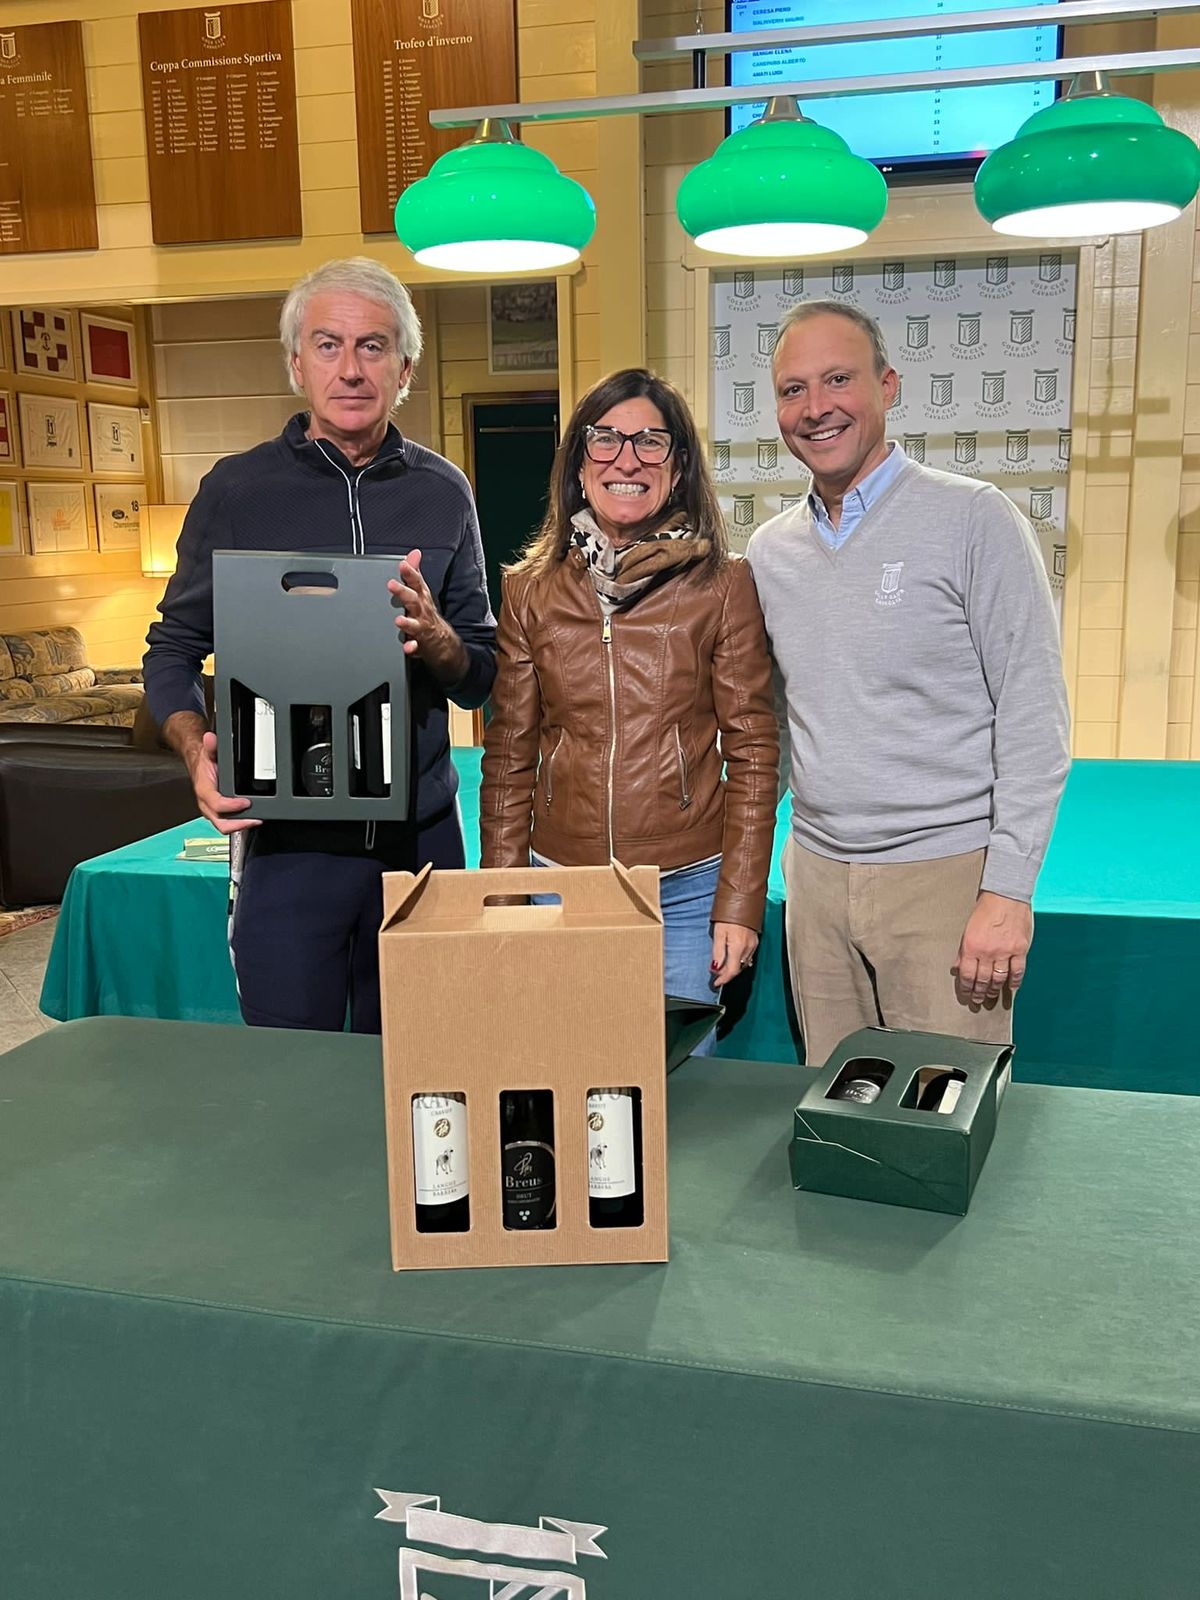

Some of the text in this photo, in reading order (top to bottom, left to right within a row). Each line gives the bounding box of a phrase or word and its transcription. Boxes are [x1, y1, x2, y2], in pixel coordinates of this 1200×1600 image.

[394, 35, 473, 50] Trofeo d'inverno
[150, 51, 282, 72] Coppa Commissione Sportiva
[7, 70, 52, 85] Femminile
